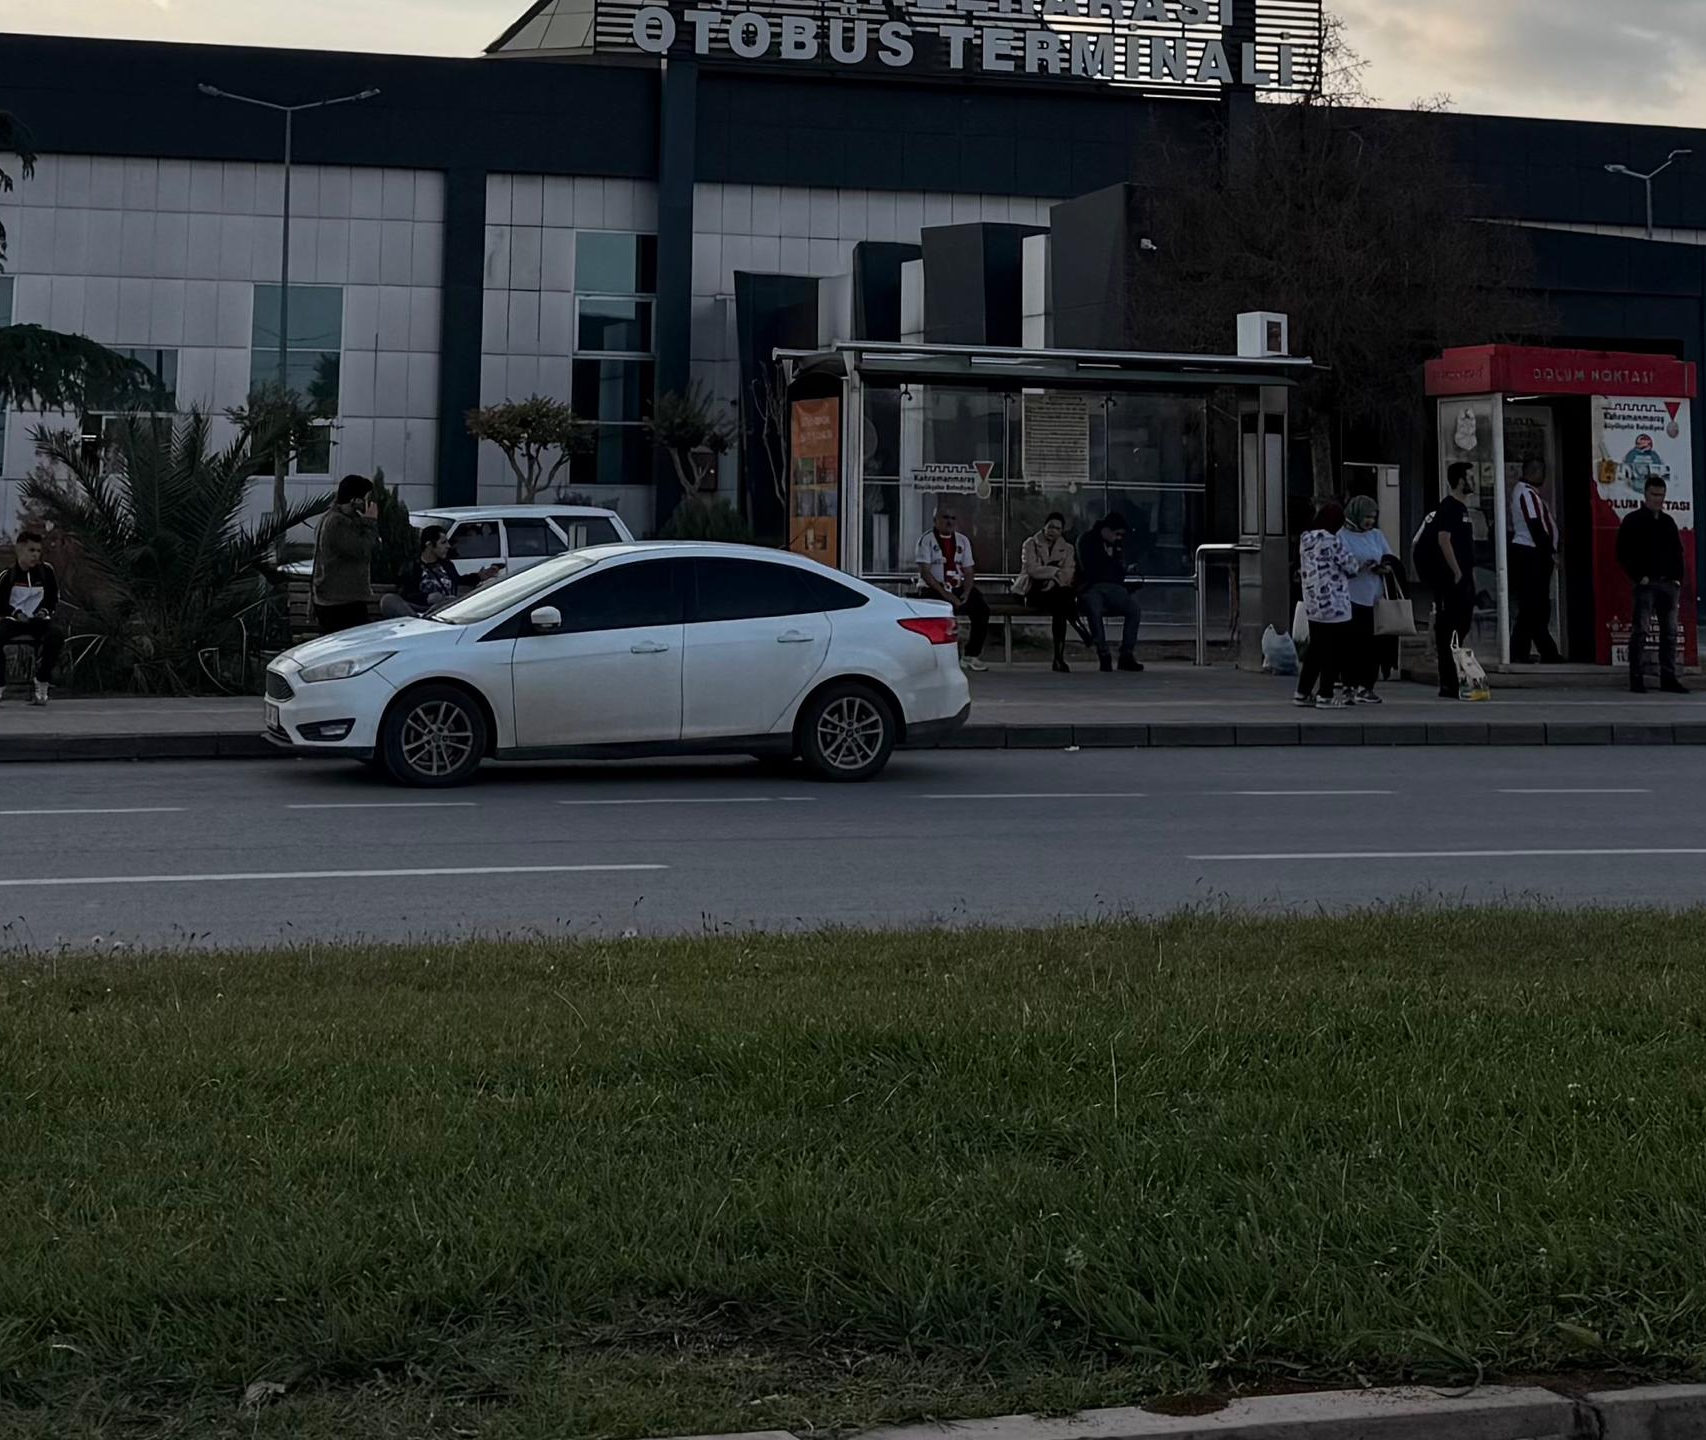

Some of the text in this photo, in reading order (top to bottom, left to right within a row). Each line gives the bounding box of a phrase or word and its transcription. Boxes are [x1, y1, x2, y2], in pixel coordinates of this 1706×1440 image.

[632, 4, 1293, 86] OTOBÜS TERMİNALİ
[1533, 367, 1654, 384] DOLUM NOKTASI
